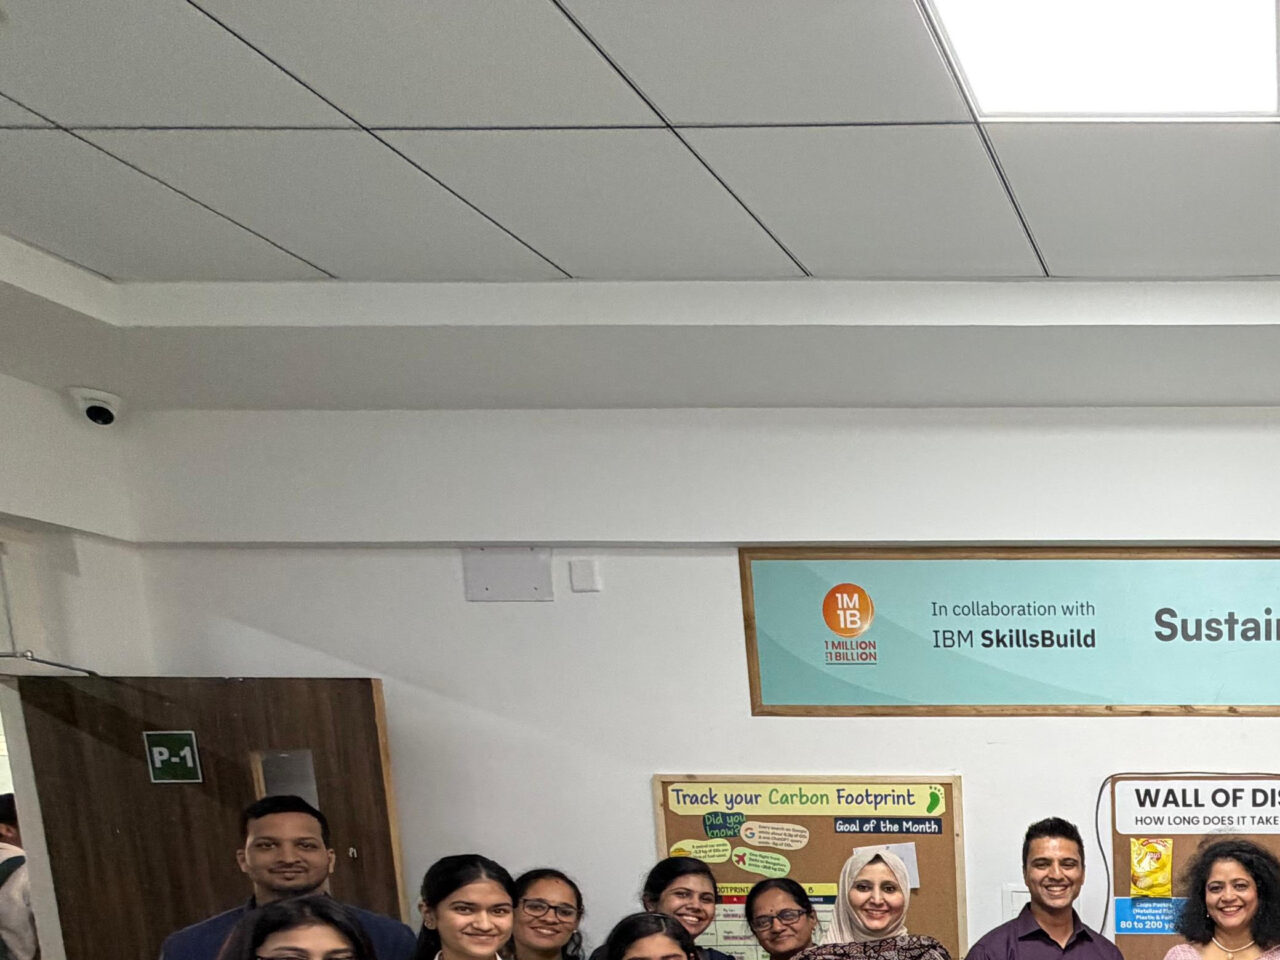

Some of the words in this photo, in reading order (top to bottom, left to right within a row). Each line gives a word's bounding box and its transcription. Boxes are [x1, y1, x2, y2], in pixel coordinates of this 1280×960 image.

[835, 593, 859, 609] 1M
[931, 601, 949, 617] In
[952, 600, 1057, 618] collaboration
[1060, 600, 1095, 617] with
[836, 610, 861, 629] 1B
[831, 640, 876, 650] MILLION
[932, 630, 975, 649] IBM
[981, 629, 1096, 649] SkillsBuild
[835, 652, 877, 662] BILLION
[151, 746, 194, 768] P-1
[671, 788, 720, 806] Track
[726, 793, 762, 811] your
[768, 787, 829, 805] Carbon
[836, 788, 916, 811] Footprint
[1135, 788, 1202, 808] WALL
[1211, 788, 1244, 808] OF
[705, 813, 724, 825] Did
[726, 814, 746, 827] you
[836, 820, 859, 832] Goal
[862, 820, 875, 832] of
[879, 820, 898, 832] the
[902, 820, 938, 833] Month
[1135, 816, 1165, 826] HOW
[1168, 816, 1200, 826] LONG
[1203, 816, 1234, 826] DOES
[1236, 816, 1248, 826] IT
[1250, 816, 1280, 826] TAKE
[706, 825, 741, 838] know?
[1120, 921, 1133, 929] 80
[1134, 921, 1144, 929] to
[1145, 921, 1163, 929] 200
